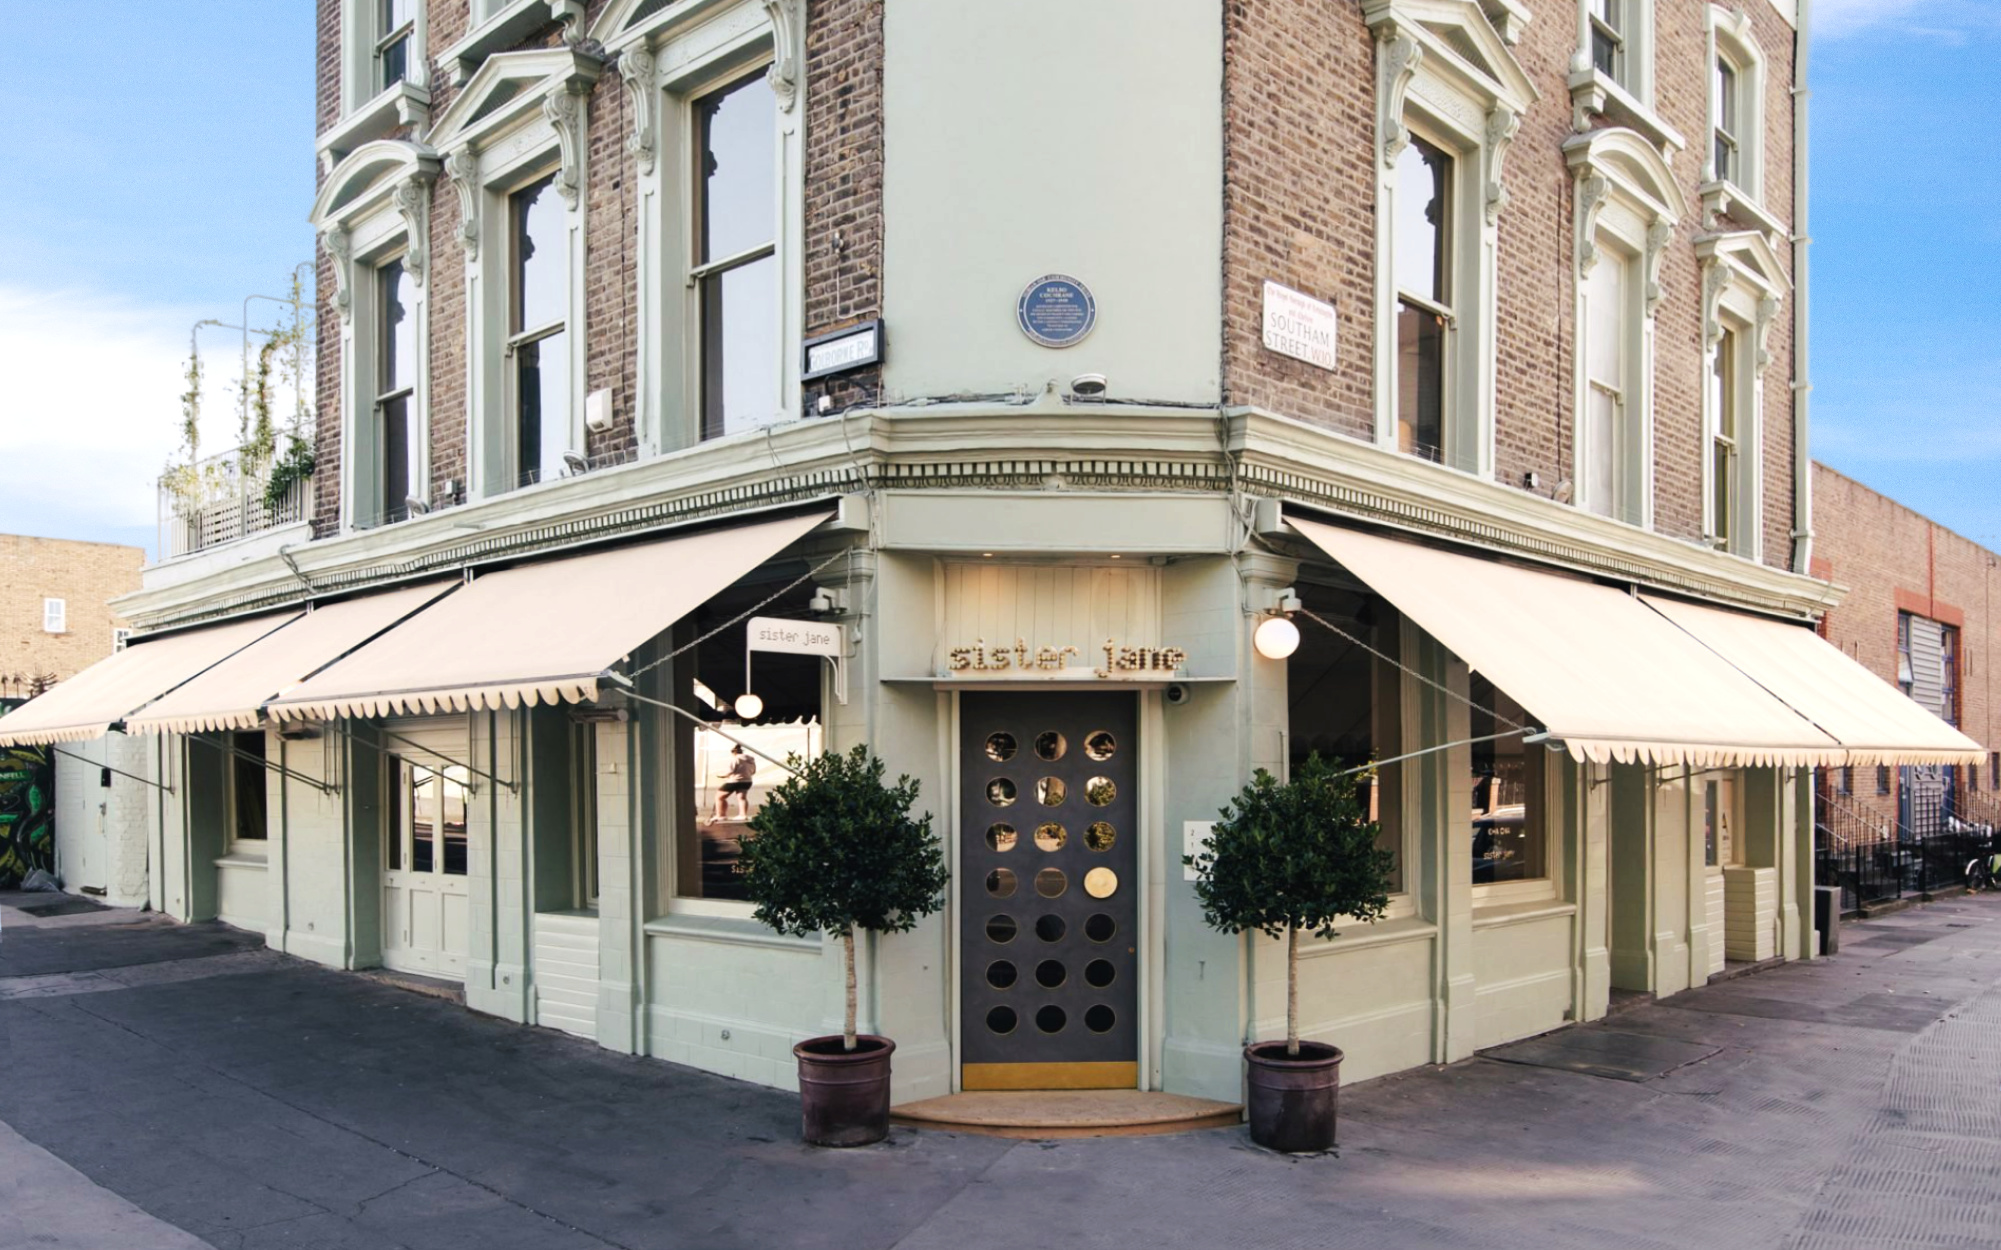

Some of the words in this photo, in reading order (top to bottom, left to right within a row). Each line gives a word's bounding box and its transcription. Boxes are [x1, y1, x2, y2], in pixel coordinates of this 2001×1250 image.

[1270, 312, 1329, 347] SOUTHAM
[759, 627, 799, 643] sister
[802, 630, 831, 646] jane
[949, 637, 1080, 671] sister
[1094, 637, 1187, 678] jane
